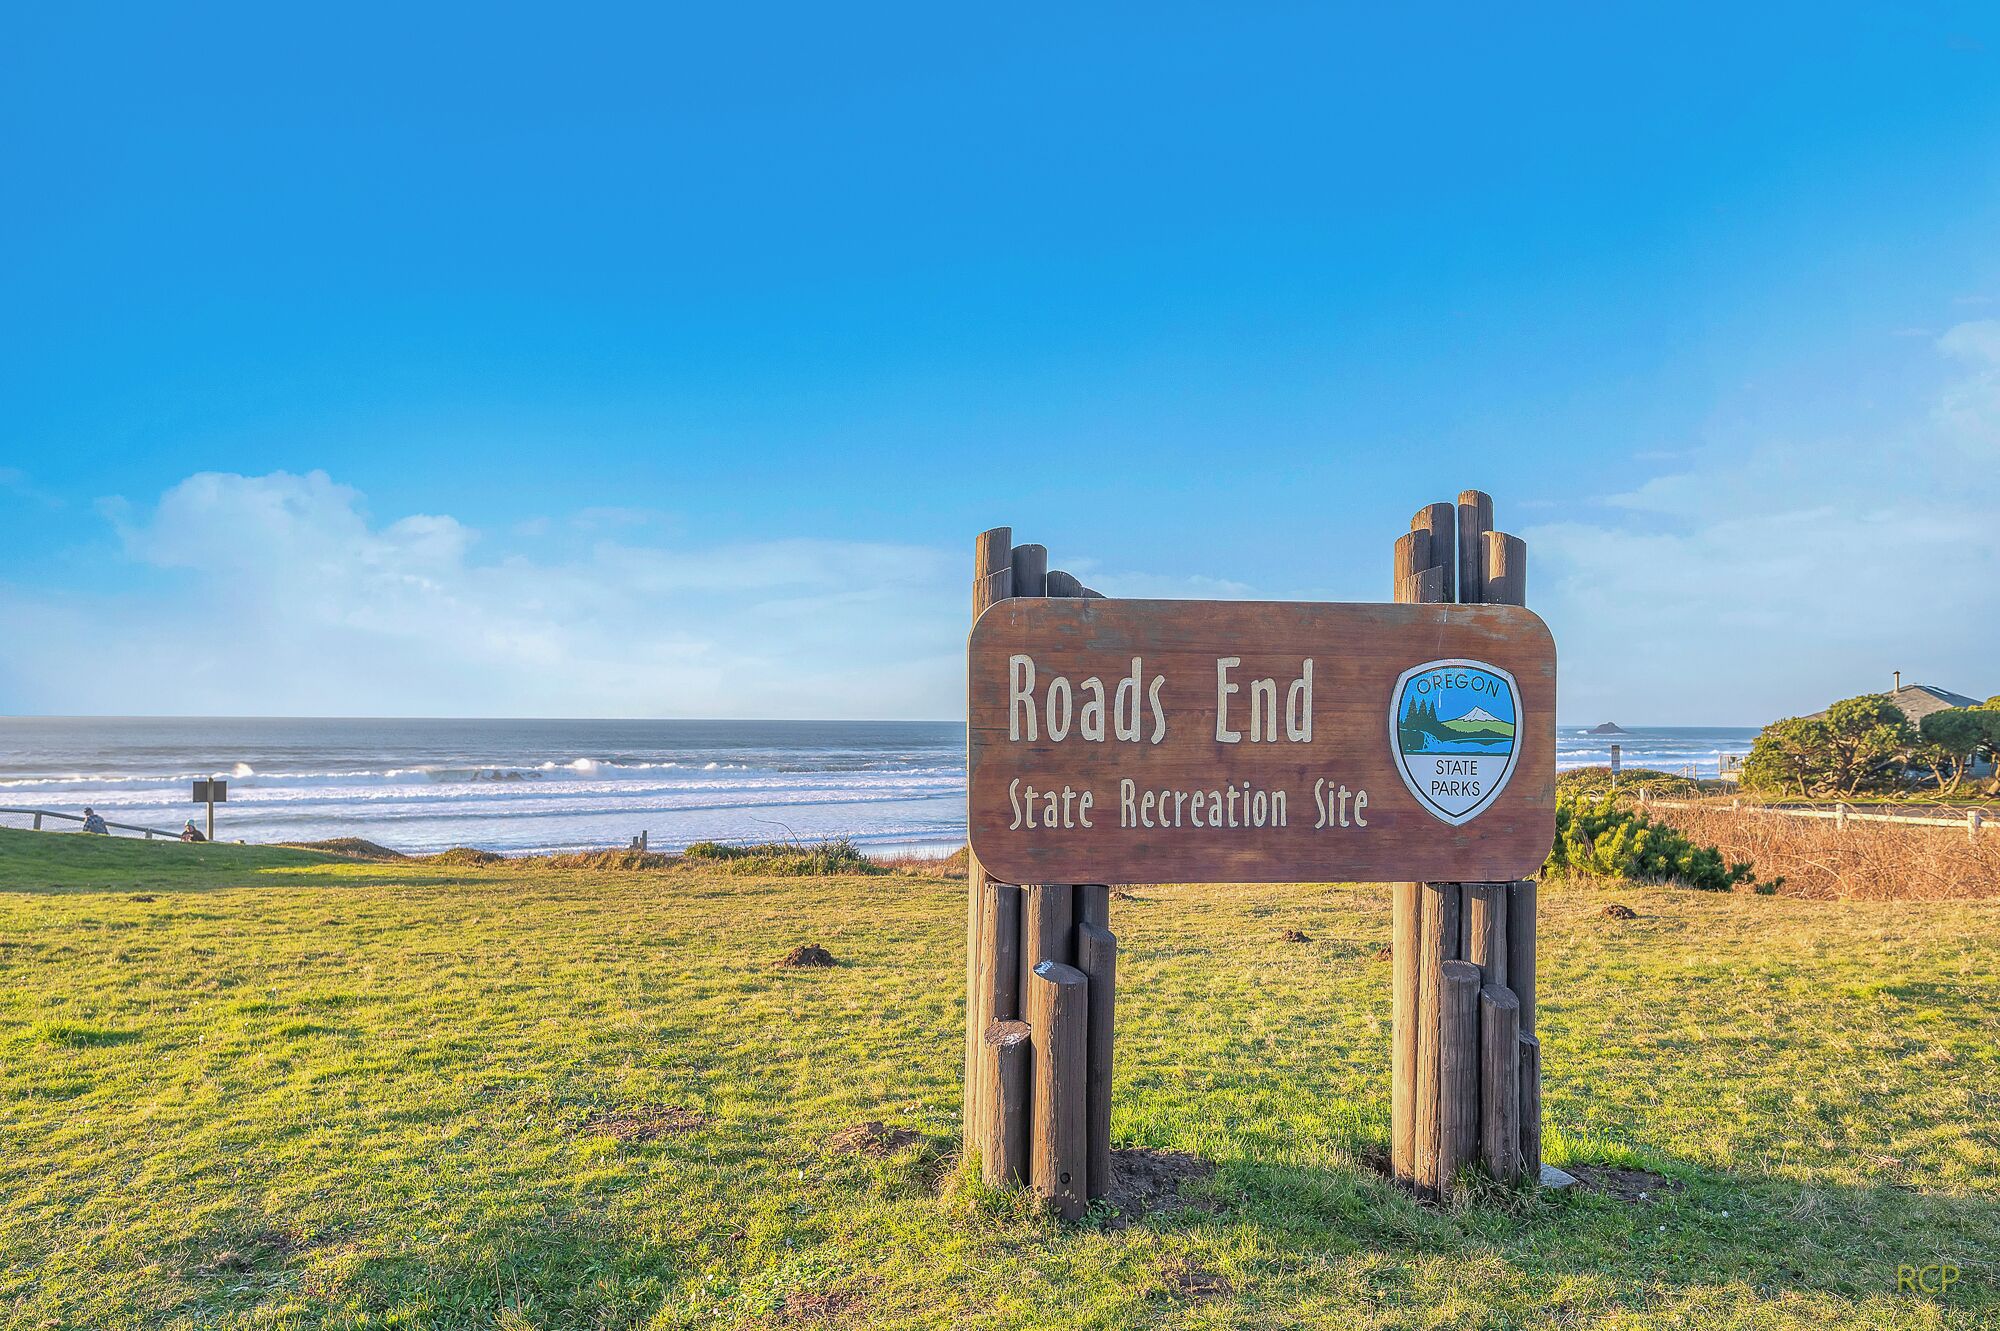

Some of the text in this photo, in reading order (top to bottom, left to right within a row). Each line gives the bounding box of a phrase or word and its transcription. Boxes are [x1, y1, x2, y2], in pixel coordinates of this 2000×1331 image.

[1416, 673, 1500, 698] OREGON
[1009, 654, 1313, 744] Roads End
[1435, 759, 1478, 776] STATE
[1431, 780, 1480, 797] PARKS
[1009, 777, 1368, 830] State Recreation Site
